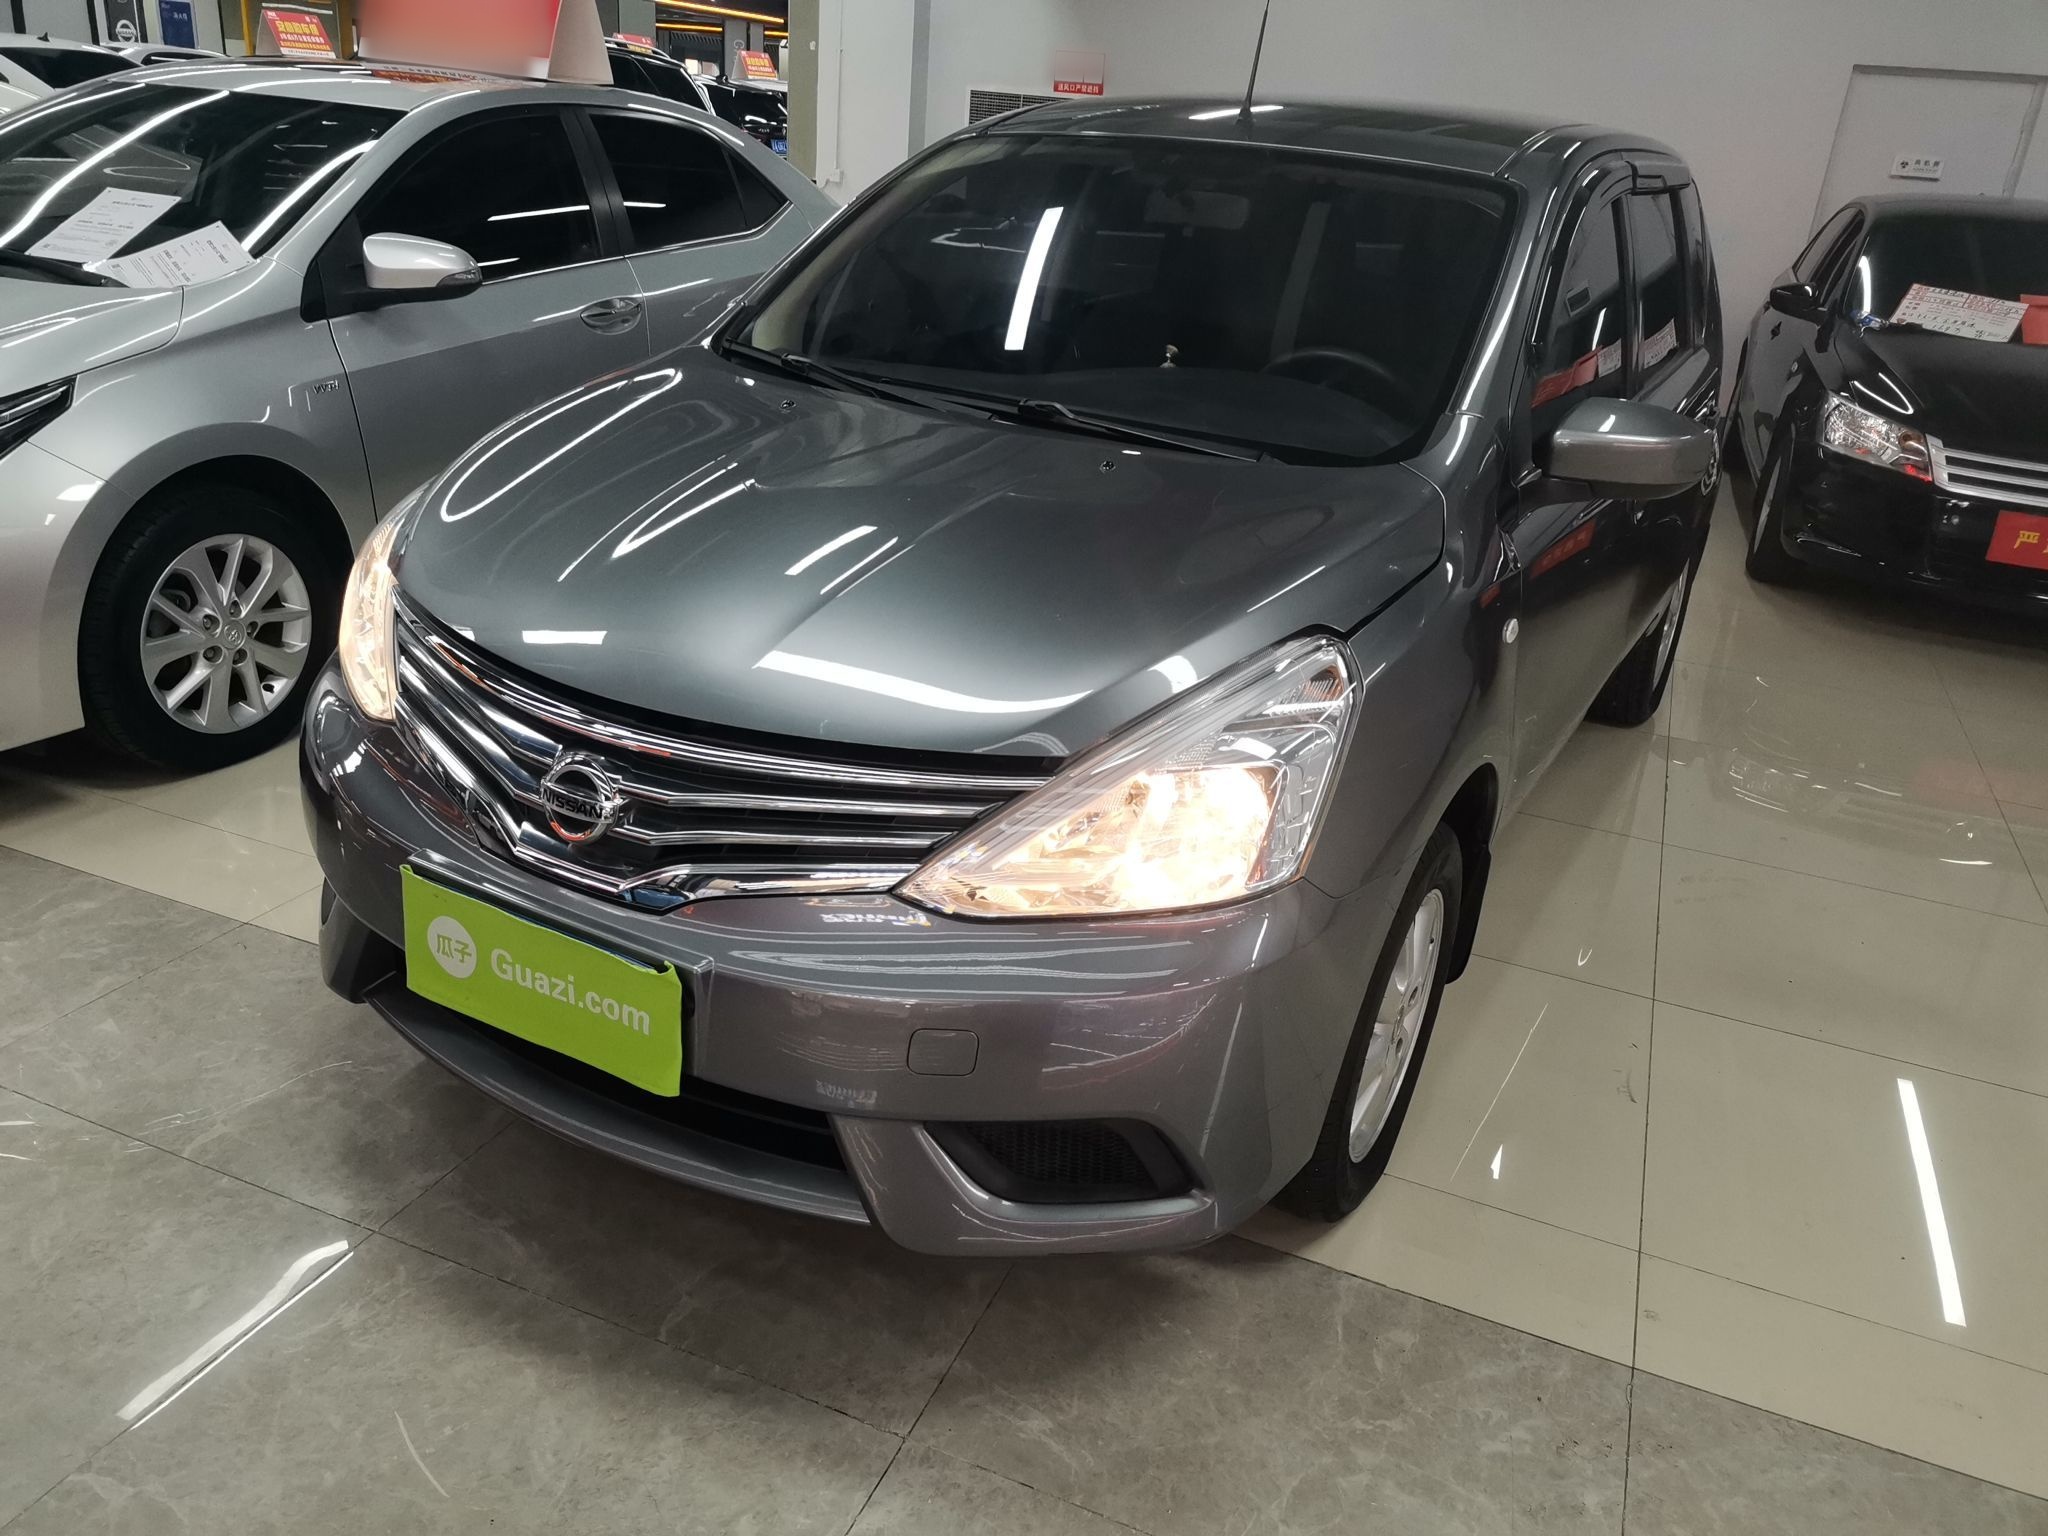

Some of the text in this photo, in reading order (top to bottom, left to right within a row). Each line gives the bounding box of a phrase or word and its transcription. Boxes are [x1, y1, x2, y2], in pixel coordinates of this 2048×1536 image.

[542, 787, 602, 819] NISSAN
[436, 933, 472, 964] 瓜子
[490, 947, 651, 1036] Guazi.com
